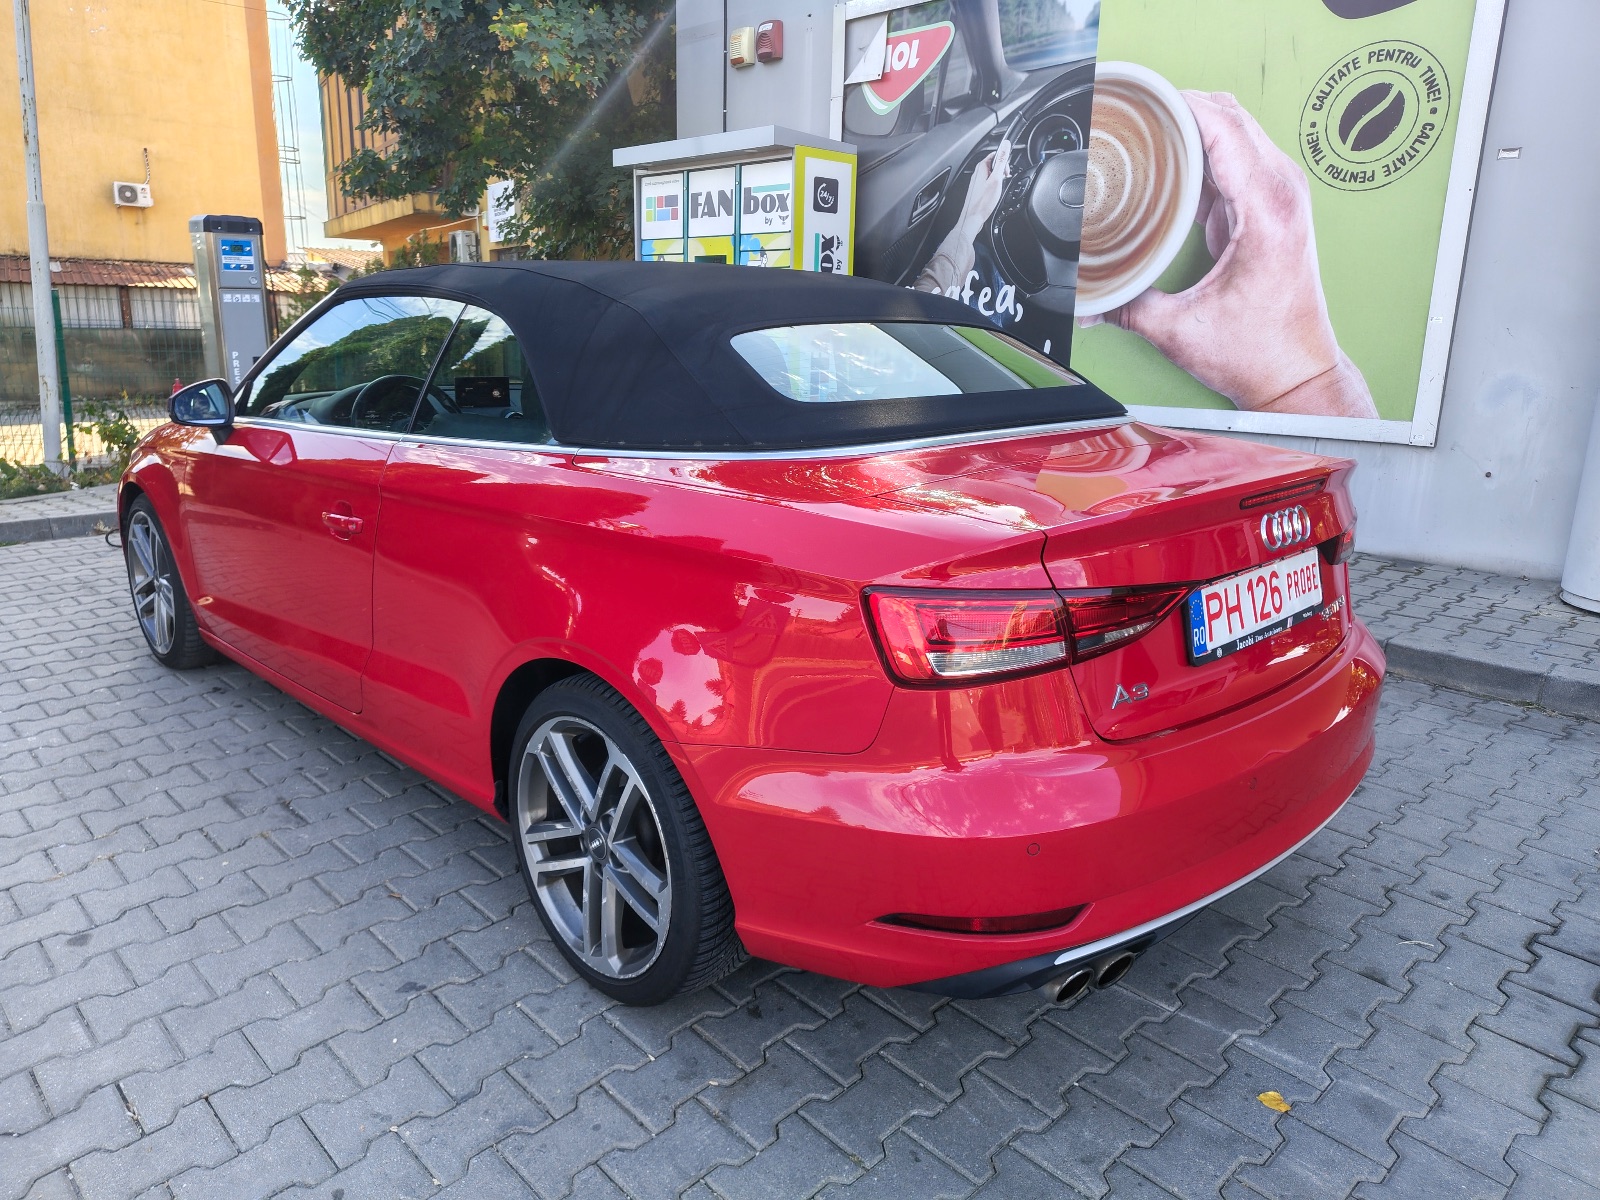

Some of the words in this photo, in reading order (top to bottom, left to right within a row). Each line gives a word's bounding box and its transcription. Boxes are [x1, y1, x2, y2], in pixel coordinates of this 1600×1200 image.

[1311, 56, 1362, 112] CALITATE
[1367, 48, 1423, 69] PENTRU
[1418, 65, 1442, 103] TINE!
[1305, 130, 1327, 166] TINE!
[1381, 122, 1436, 178] CALITATE
[1324, 163, 1376, 184] PENTRU
[690, 188, 734, 219] FAN
[742, 186, 790, 215] box
[764, 216, 773, 226] by
[835, 258, 843, 270] by
[232, 351, 241, 384] PRES
[1204, 583, 1245, 643] PH
[1246, 570, 1283, 624] 126
[1286, 562, 1319, 601] PROBE
[1193, 627, 1206, 648] RO
[1236, 634, 1254, 651] Jacobi
[1111, 682, 1149, 710] A3
